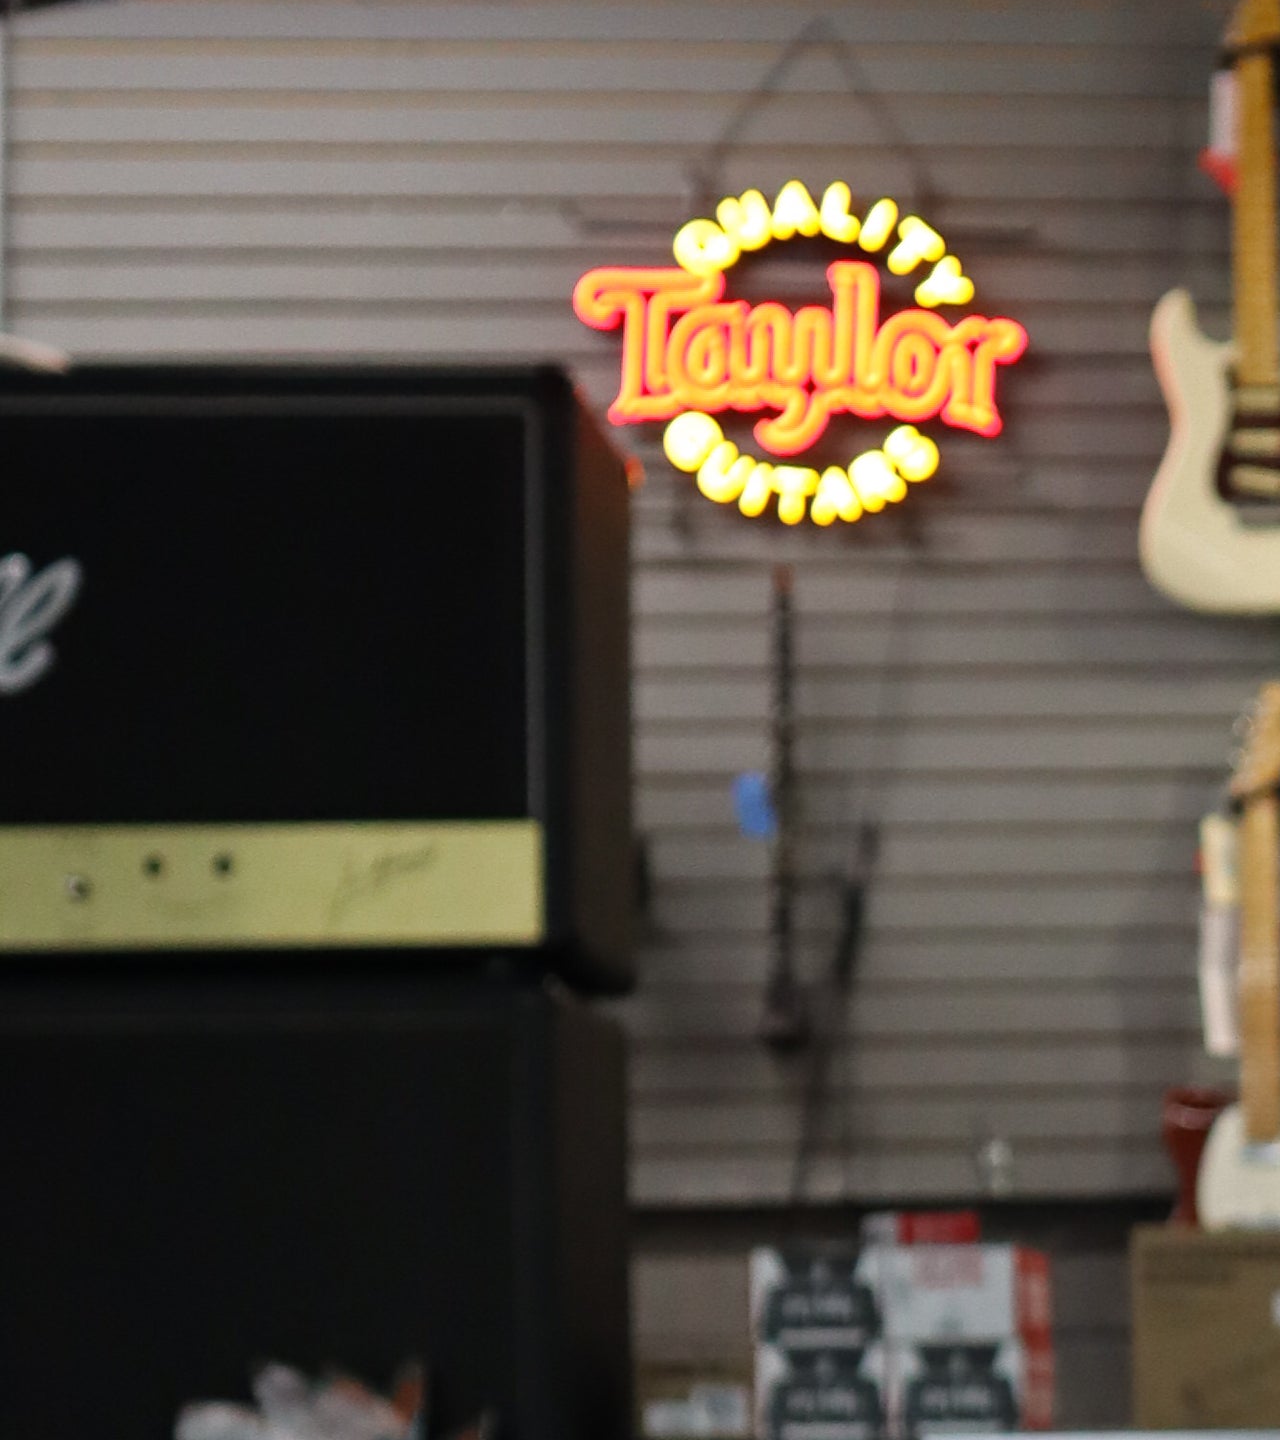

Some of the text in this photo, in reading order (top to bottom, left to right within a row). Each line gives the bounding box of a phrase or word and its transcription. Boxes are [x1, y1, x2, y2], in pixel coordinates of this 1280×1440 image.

[673, 180, 975, 309] QUALITY
[573, 259, 1029, 457] Taylor
[663, 411, 940, 527] GUITARS
